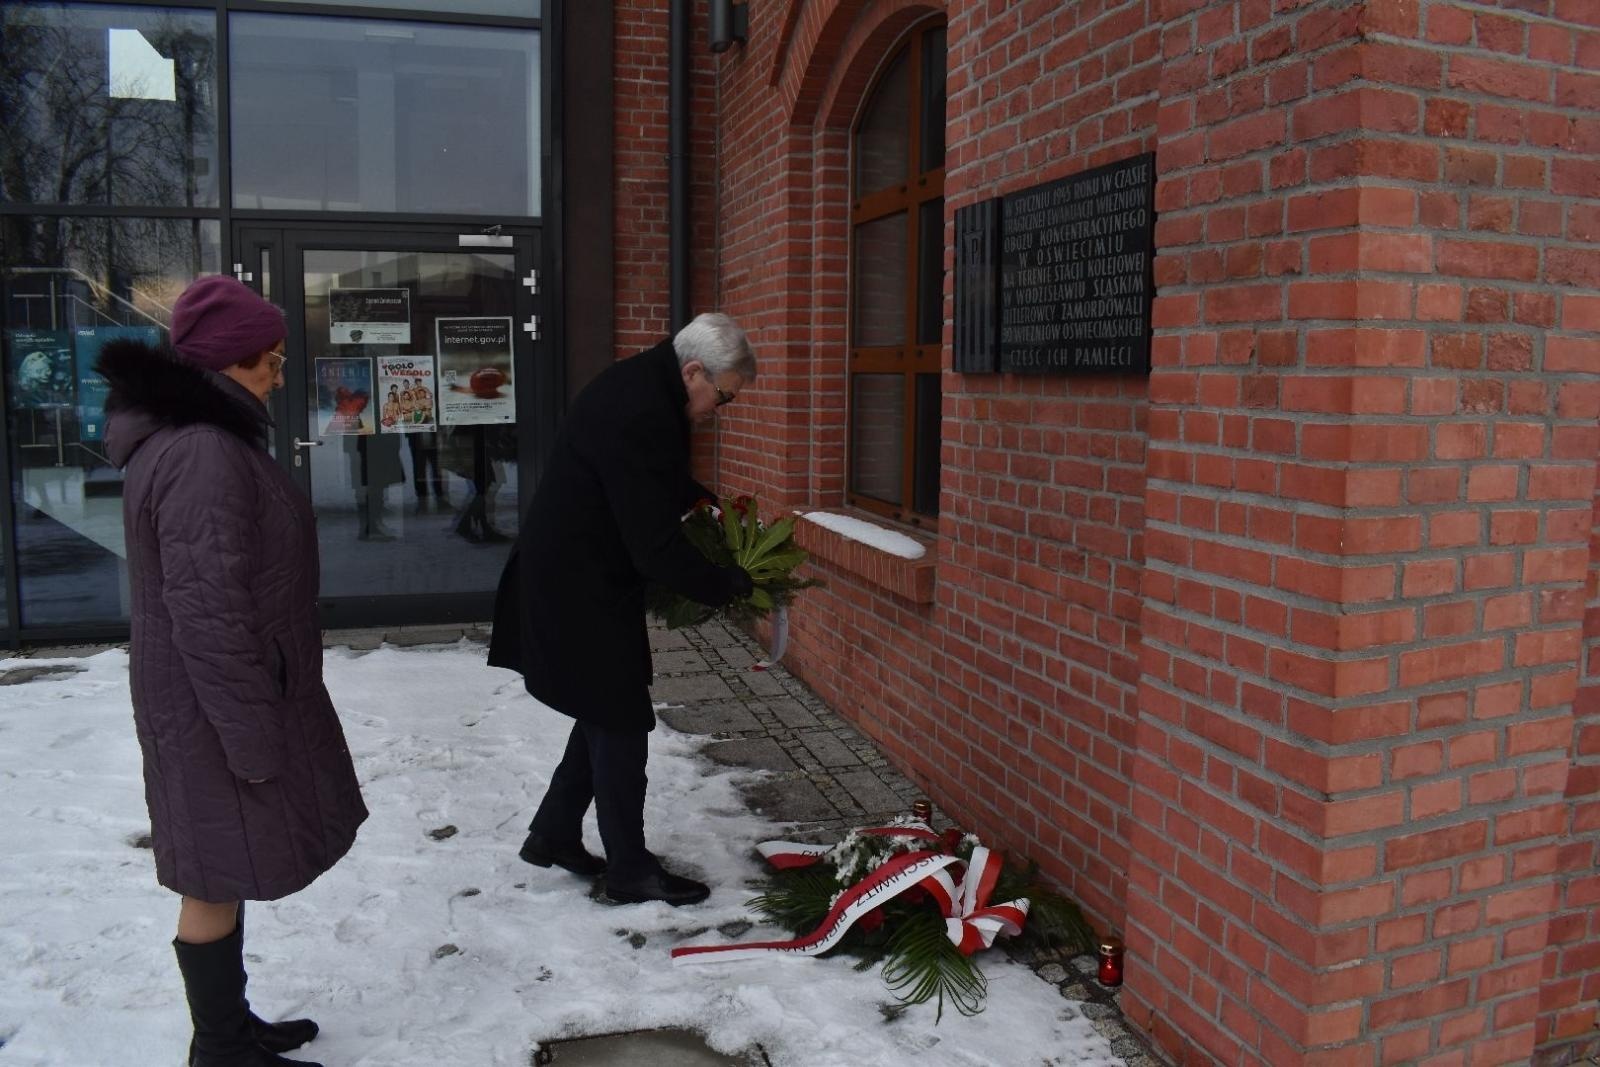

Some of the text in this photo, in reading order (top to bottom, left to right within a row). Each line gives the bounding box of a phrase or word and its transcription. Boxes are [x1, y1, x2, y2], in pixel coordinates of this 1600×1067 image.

[1074, 177, 1100, 199] ROKU
[1102, 174, 1112, 193] W
[1115, 164, 1147, 189] CZASIE
[1040, 208, 1146, 247] KONCENTRACYJNEGO
[1018, 266, 1052, 287] TERENIE
[1087, 251, 1145, 277] KOLEJOWEJ
[1019, 251, 1028, 269] W
[1061, 295, 1143, 321] ZAMORDOWALI
[444, 334, 506, 345] internet.gov.pl
[1048, 347, 1068, 366] ICH
